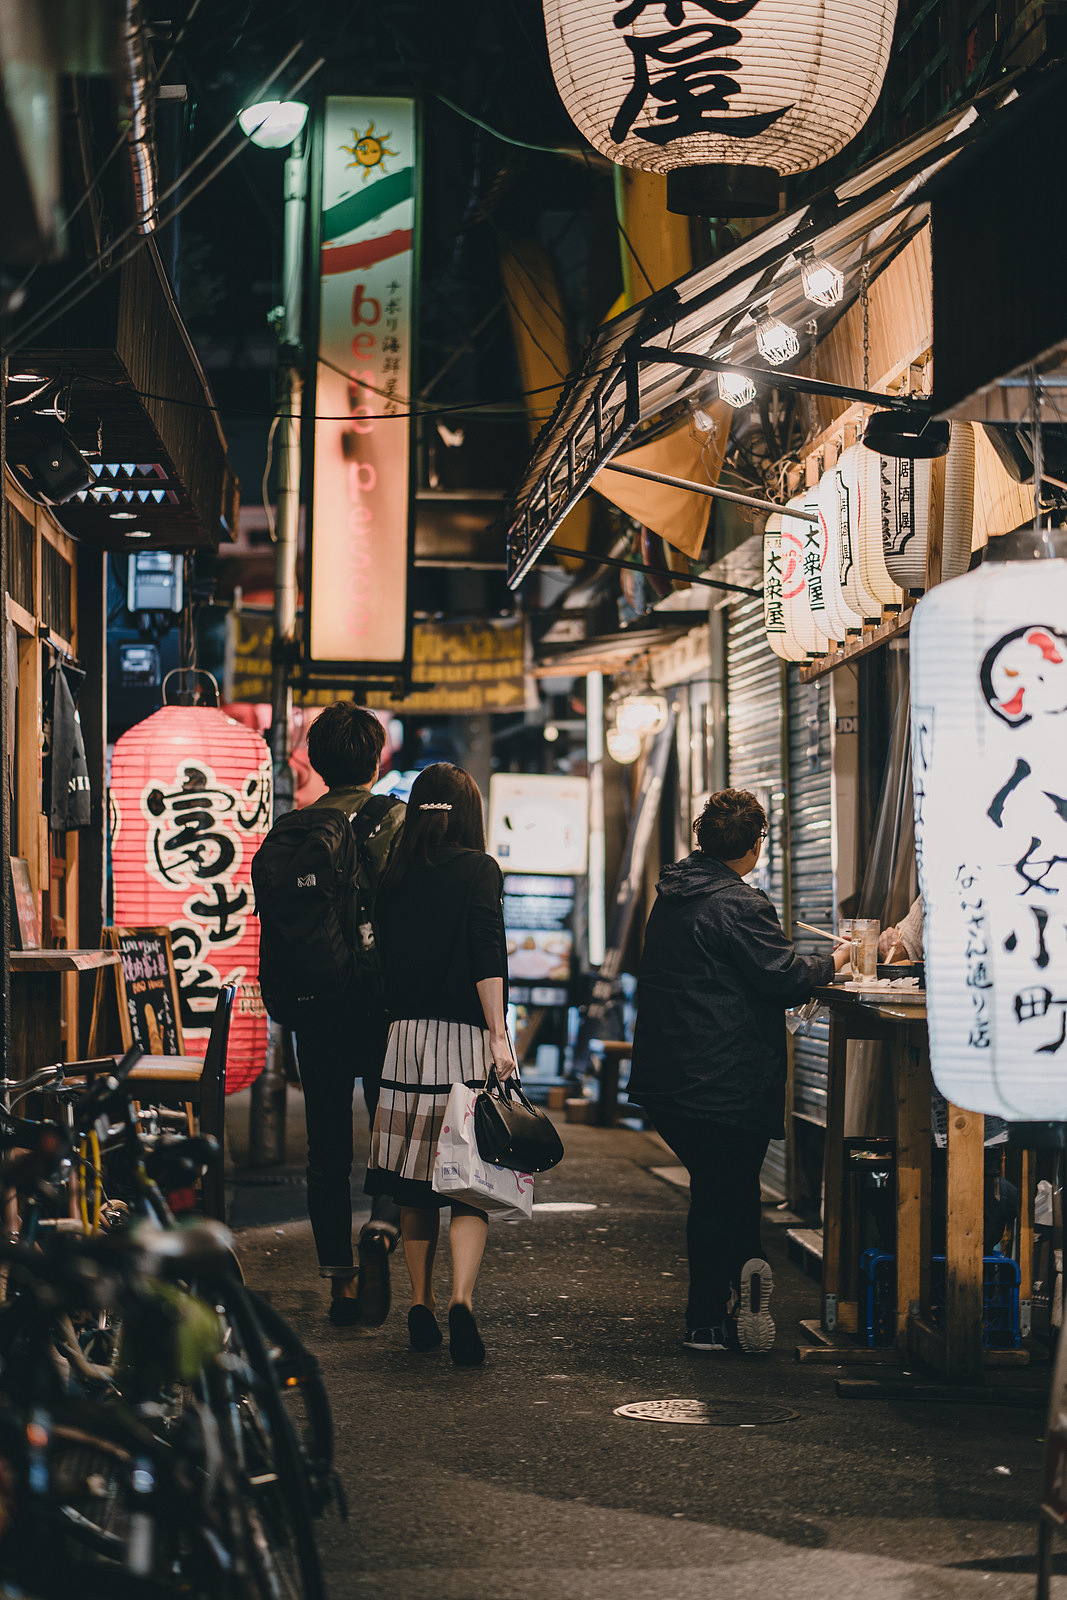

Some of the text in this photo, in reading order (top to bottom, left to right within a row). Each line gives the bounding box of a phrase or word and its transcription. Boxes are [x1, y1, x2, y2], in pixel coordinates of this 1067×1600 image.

[765, 550, 785, 626] 大衆屋
[803, 524, 824, 603] 大衆屋
